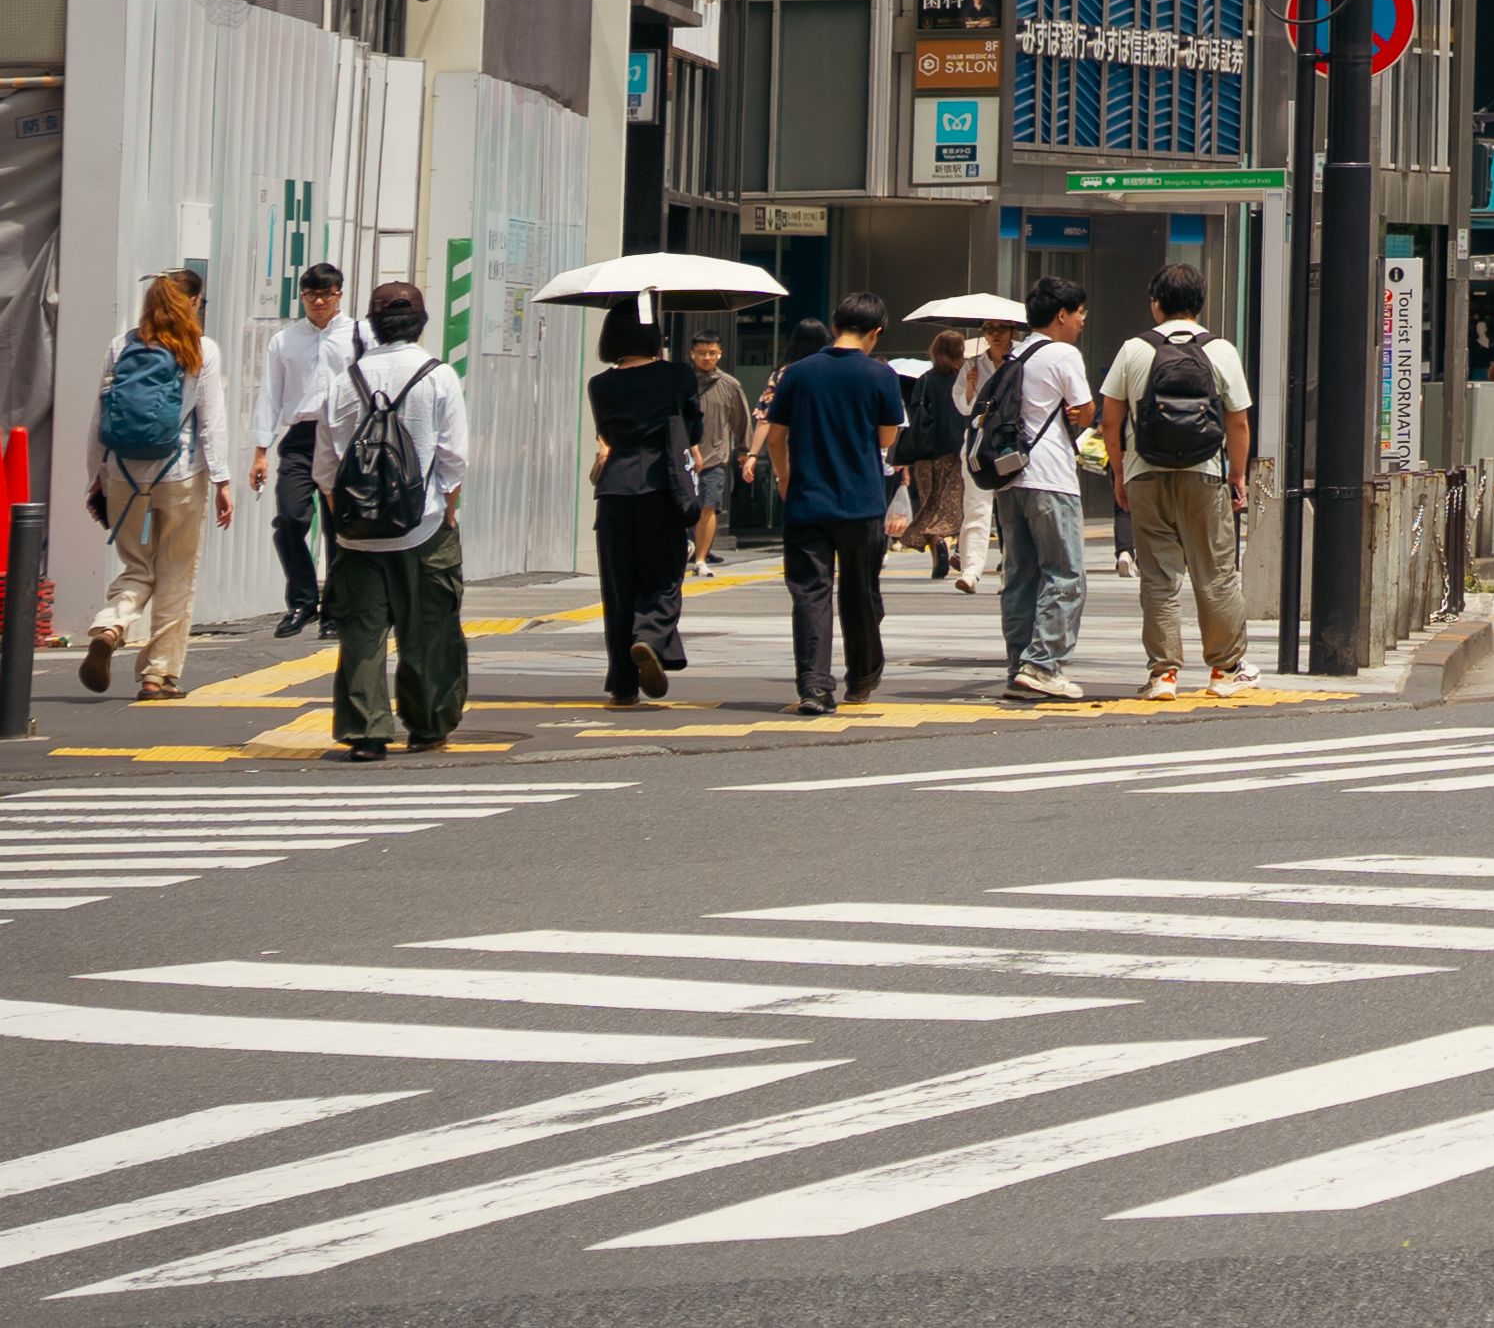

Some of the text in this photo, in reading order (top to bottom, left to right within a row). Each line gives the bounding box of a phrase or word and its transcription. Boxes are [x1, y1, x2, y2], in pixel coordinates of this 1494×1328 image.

[984, 40, 999, 51] 8F
[1020, 19, 1245, 74] みずほ銀行 みずほ信託銀行 みずほ証券
[934, 164, 963, 174] 新宿駅
[1122, 177, 1162, 186] 新宿駅東口
[1397, 288, 1413, 473] Tourist INFORMATION
